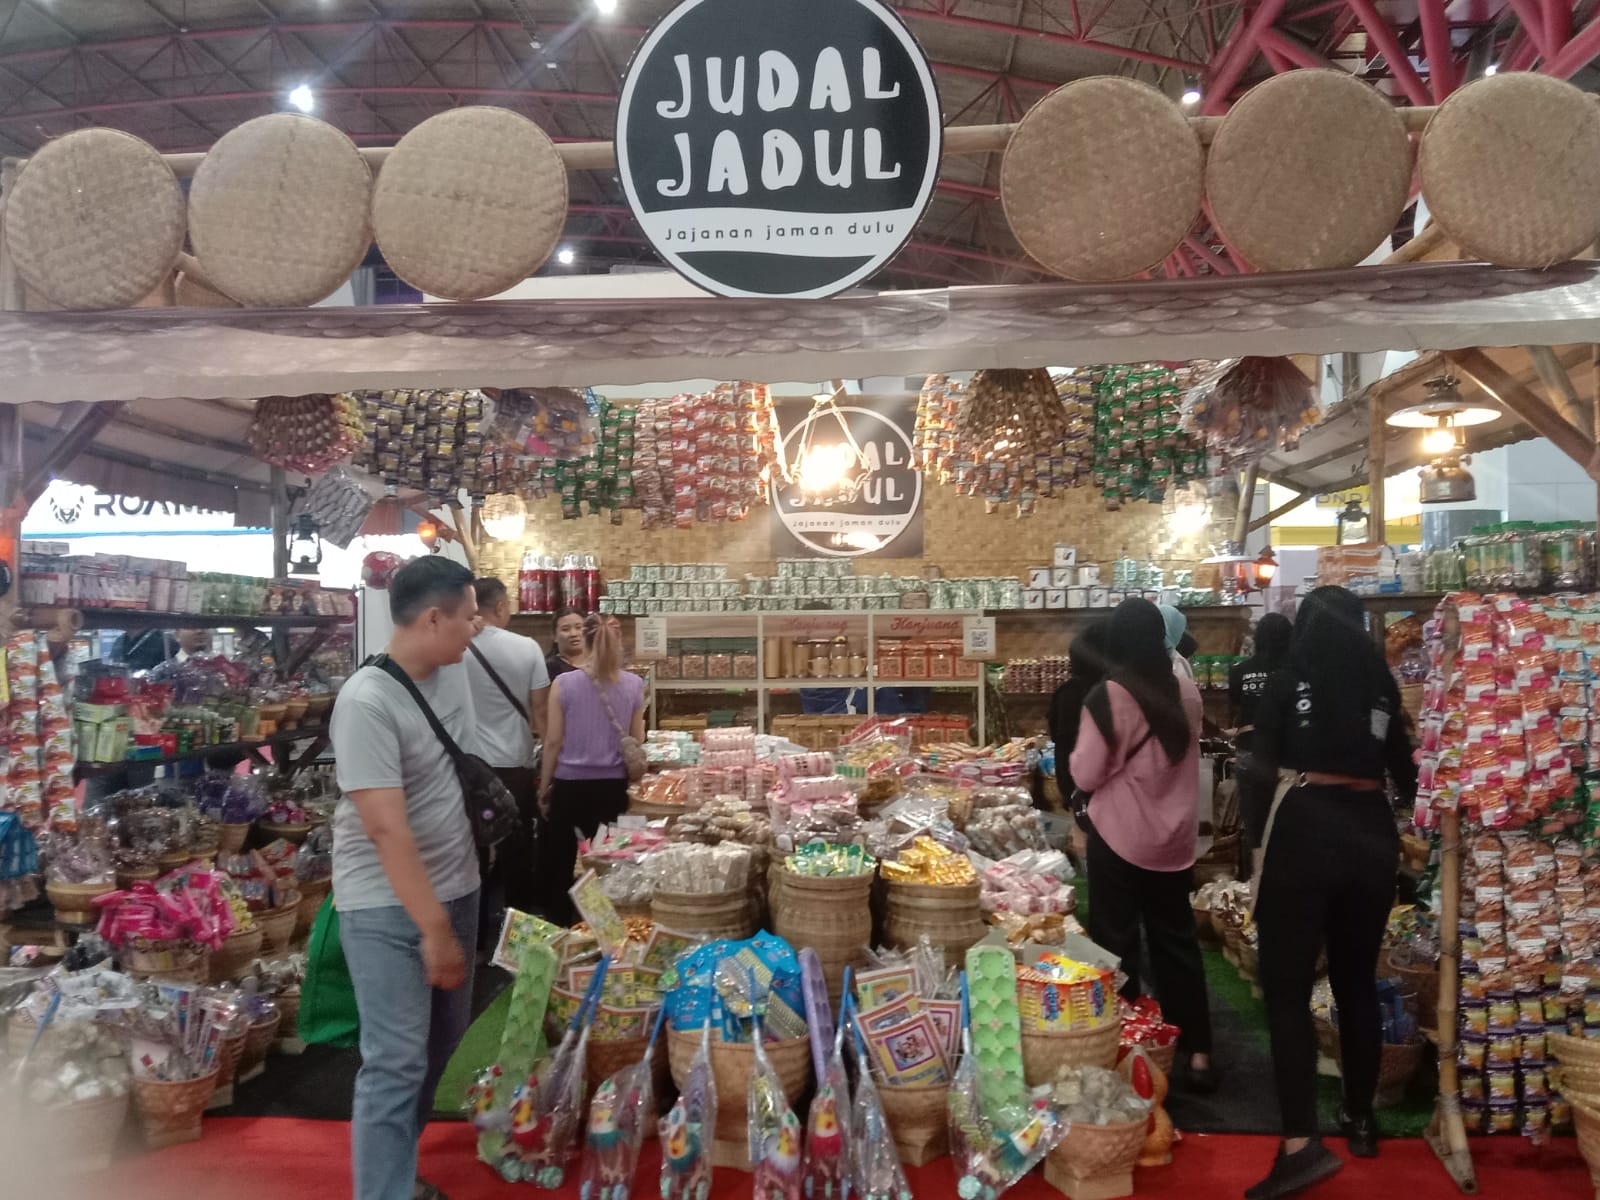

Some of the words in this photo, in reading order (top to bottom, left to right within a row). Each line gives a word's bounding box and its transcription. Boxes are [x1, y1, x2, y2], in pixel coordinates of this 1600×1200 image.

[656, 46, 900, 119] JUDAL
[656, 128, 901, 197] JADUL
[665, 227, 753, 243] Jajanan
[766, 223, 834, 241] jaman
[848, 221, 895, 236] dulu
